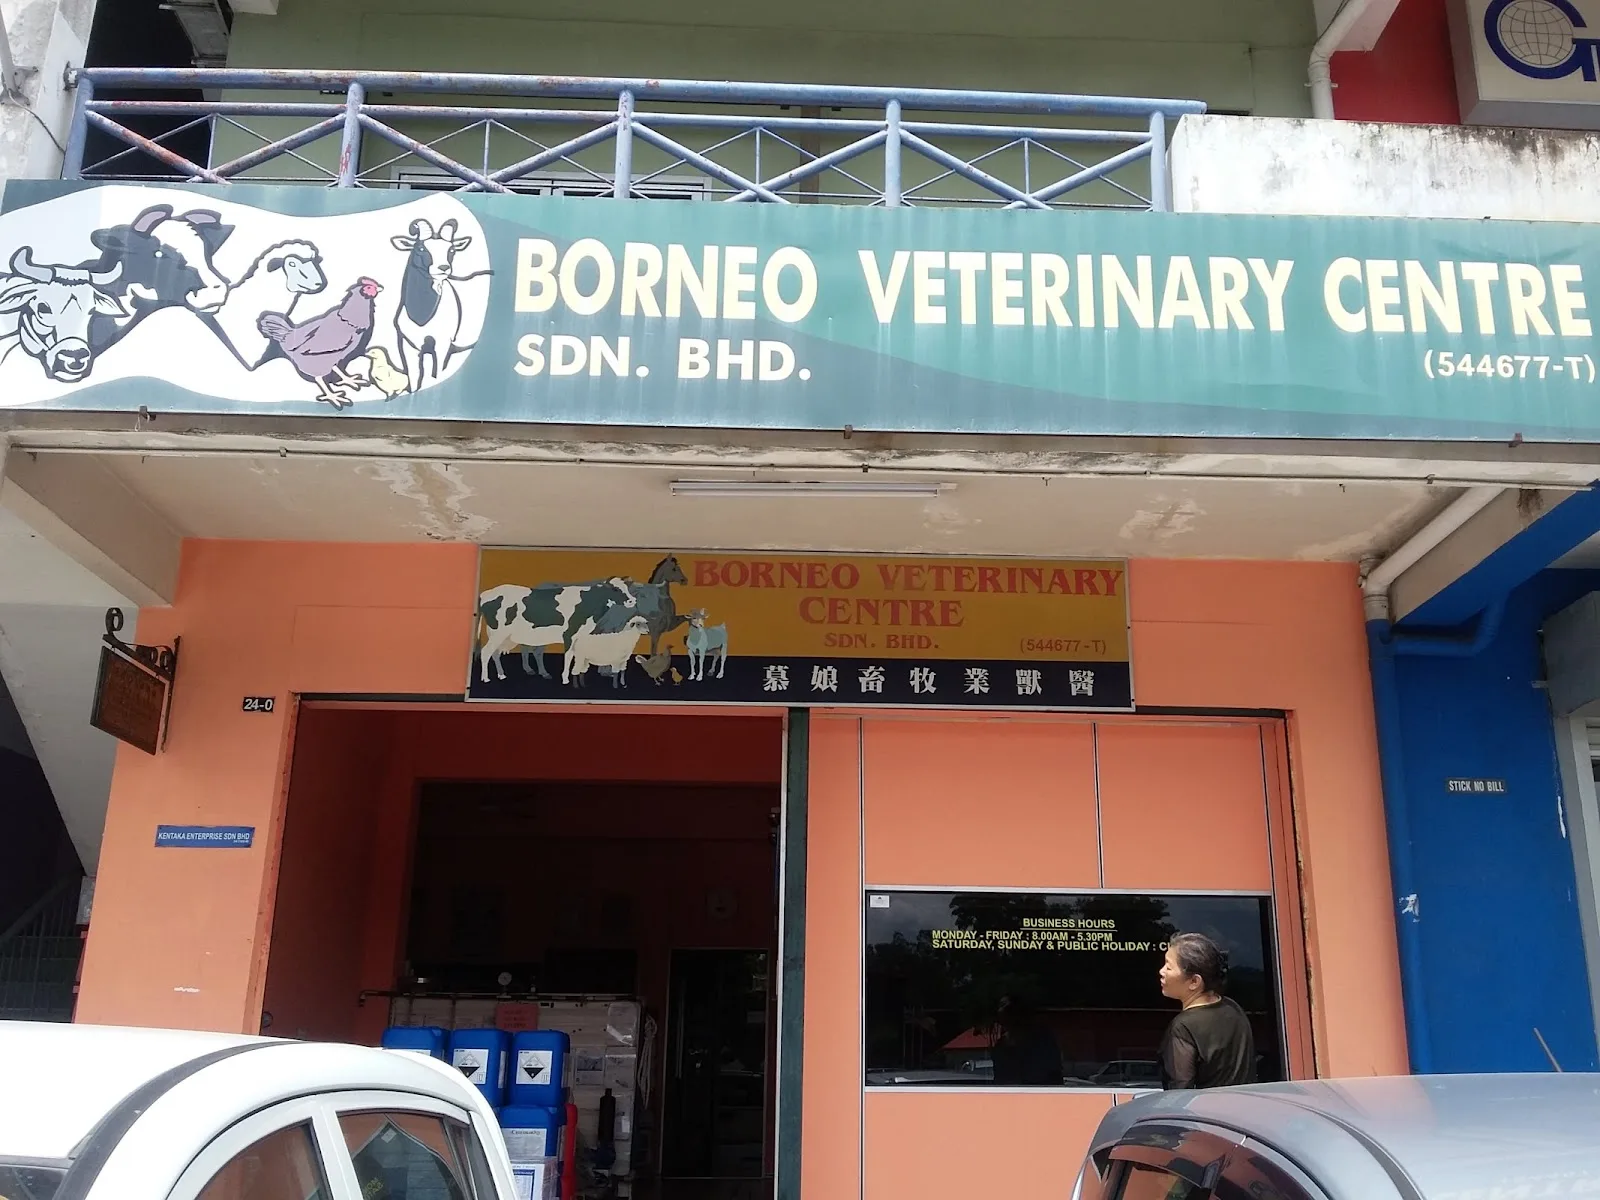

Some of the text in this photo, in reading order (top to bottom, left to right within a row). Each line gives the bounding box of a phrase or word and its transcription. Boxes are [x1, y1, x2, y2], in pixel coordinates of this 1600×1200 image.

[514, 237, 1593, 337] BORNEO VETERINARY CENTRE
[513, 333, 812, 381] SDN. BHD.
[1424, 349, 1596, 384] (544677-T)
[693, 560, 1123, 596] BORNEO VETERINARY
[799, 596, 965, 627] CENTRE
[824, 633, 939, 649] SDN. BHD.
[243, 698, 273, 711] 24-0
[1449, 780, 1504, 792] STICK NO BILL
[158, 832, 250, 840] KENTAKA ENTERPRISE SDN BHD
[1023, 918, 1116, 929] BUSINESS HOURS
[932, 930, 978, 940] MONDAY
[986, 930, 1023, 940] FRIDAY
[1032, 931, 1069, 941] 8.00AM
[1077, 932, 1113, 942] 5.30PM
[932, 940, 995, 951] SATURDAY,
[998, 940, 1043, 950] SUNDAY
[1046, 941, 1054, 950] &
[1057, 941, 1099, 951] PUBLIC
[1102, 941, 1151, 951] HOLIDAY
